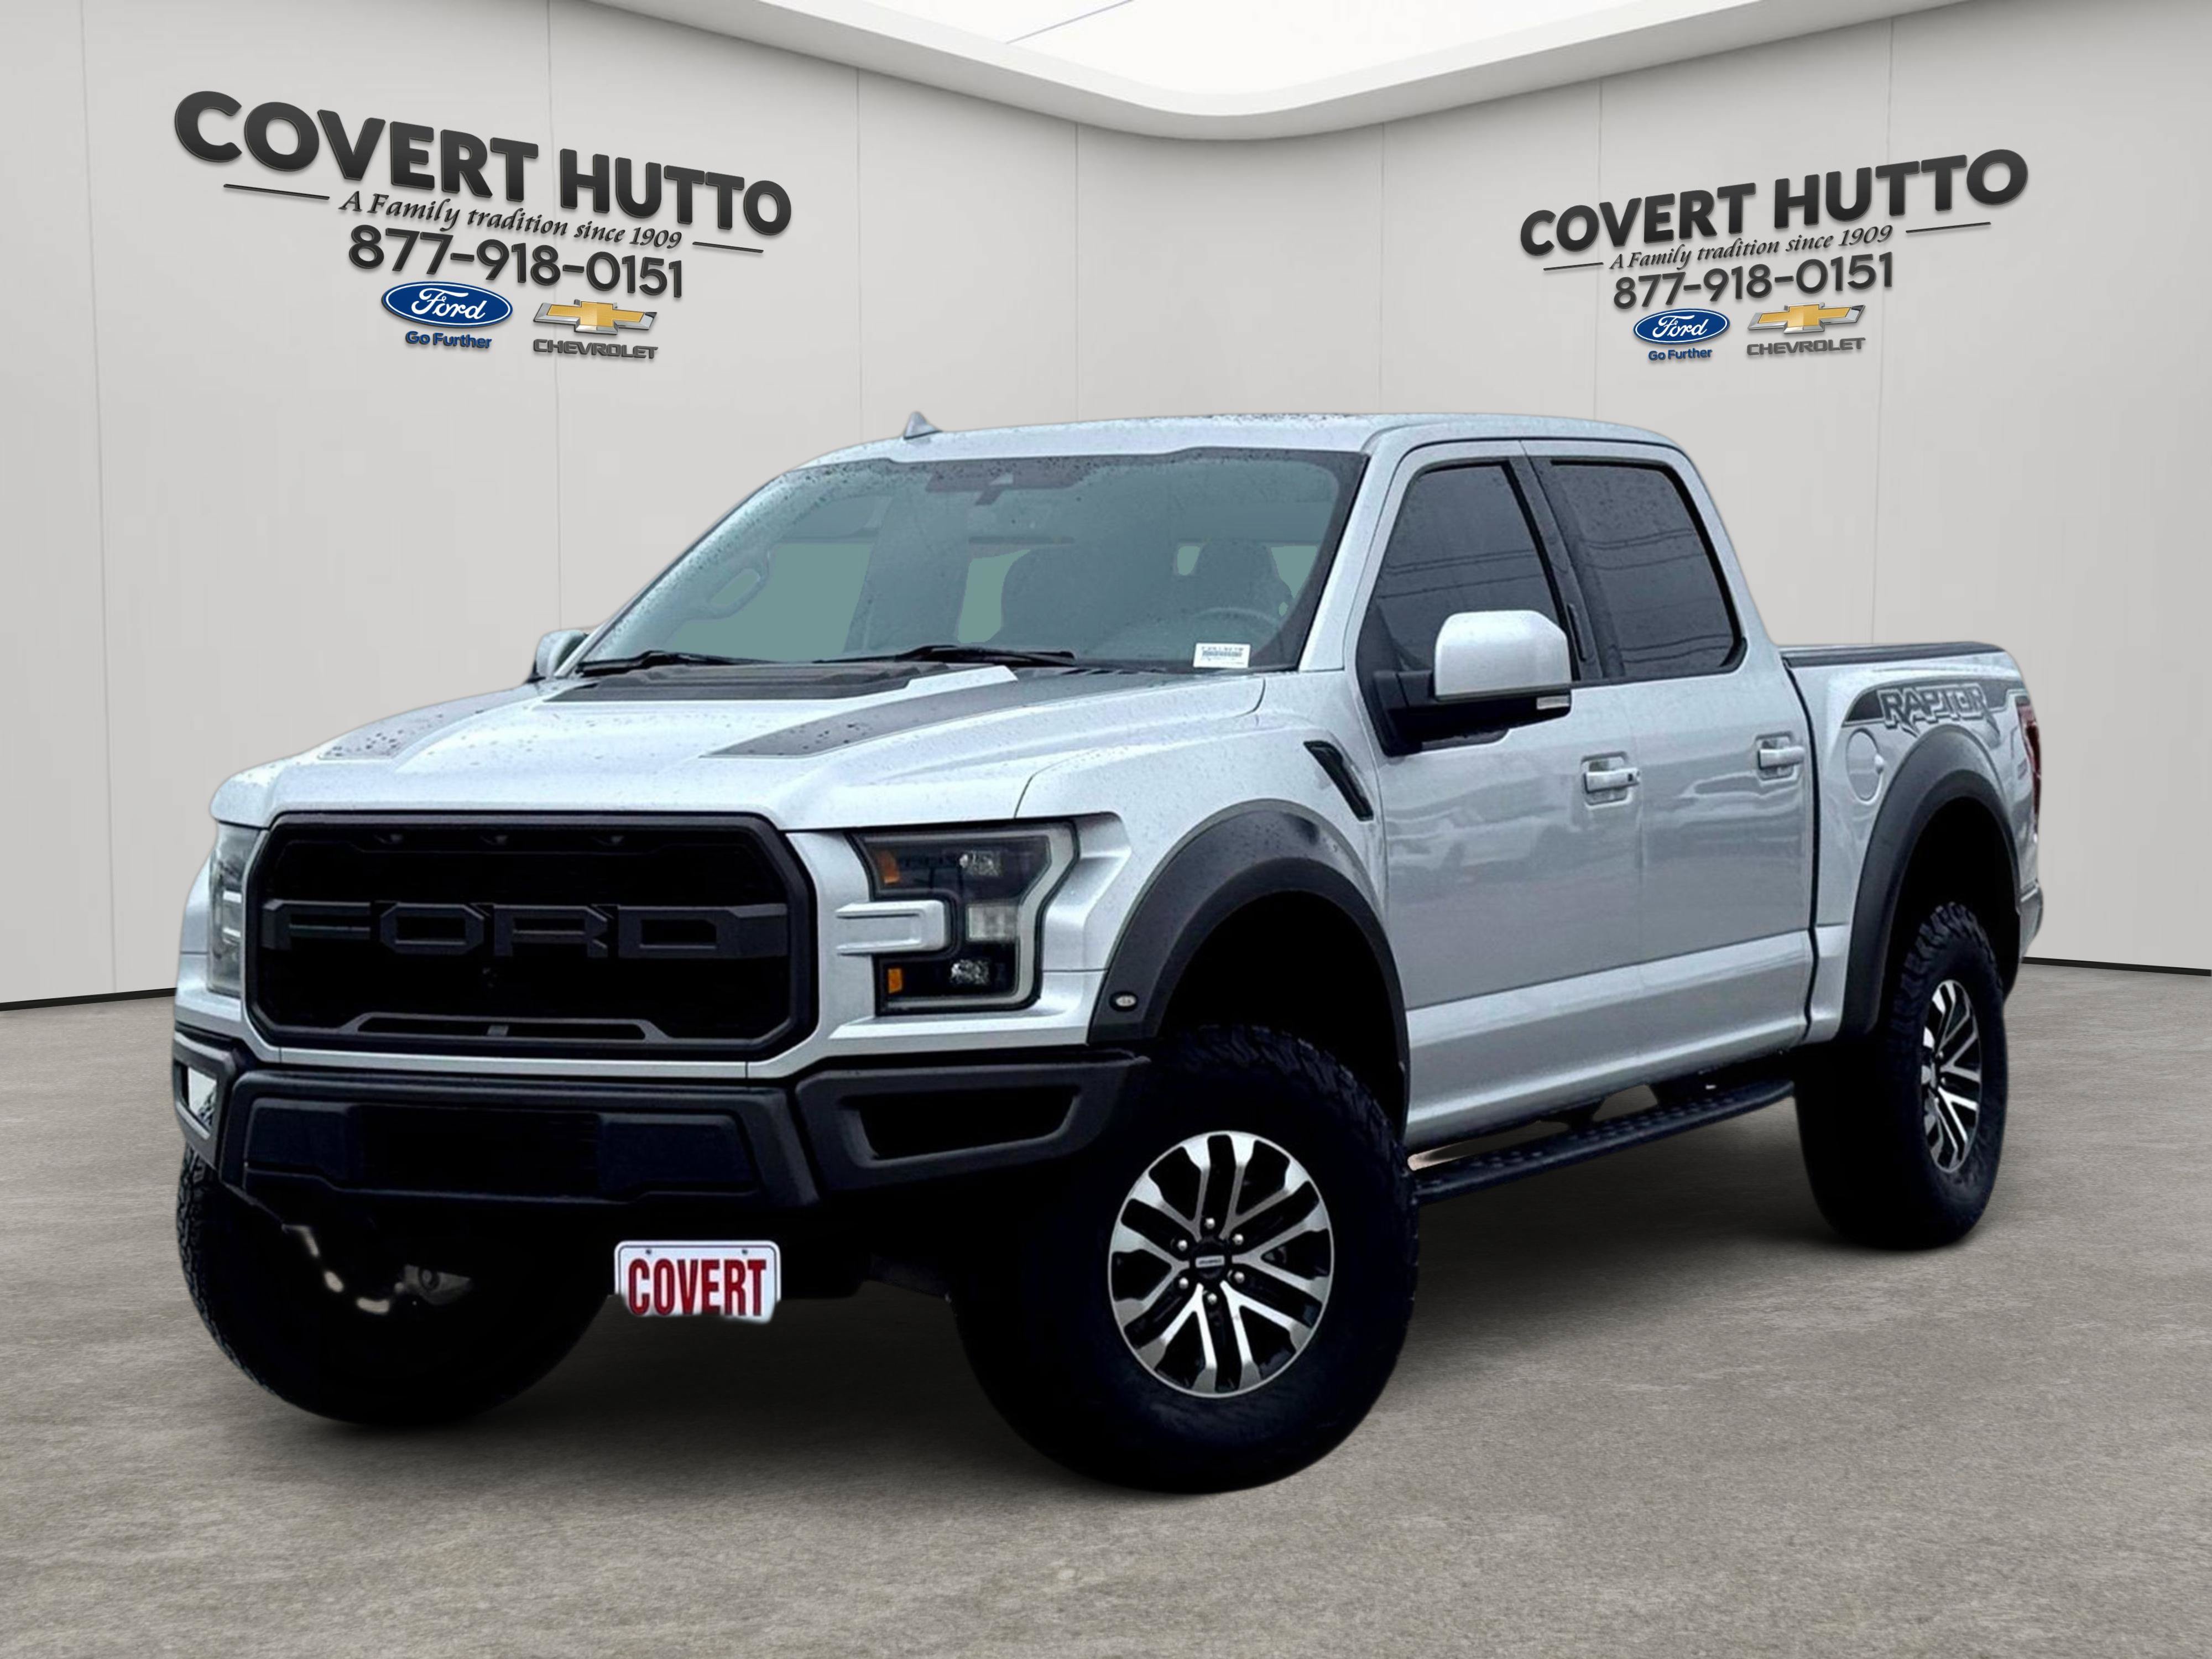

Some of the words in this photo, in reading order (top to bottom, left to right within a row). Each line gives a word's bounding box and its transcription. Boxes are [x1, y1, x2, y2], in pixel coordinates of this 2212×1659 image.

[174, 90, 539, 202] COVERT
[560, 148, 791, 237] HUTTO
[338, 191, 362, 212] A
[367, 193, 460, 232] Family
[467, 208, 568, 236] tradition
[574, 221, 625, 243] since
[629, 227, 682, 249] 1909
[1520, 182, 1756, 257] COVERT
[1774, 149, 2028, 229] HUTTO
[348, 225, 682, 298] 877-918-0151
[1609, 254, 1624, 269] A
[1627, 244, 1692, 270] Family
[1697, 238, 1780, 261] tradition
[1785, 234, 1834, 252] since
[1838, 225, 1893, 247] 1909
[411, 287, 487, 320] Ford
[1614, 252, 1892, 309] 877-918-0151
[405, 330, 430, 345] Go
[434, 332, 492, 349] Further
[533, 338, 659, 359] CHEVROLET
[1648, 350, 1666, 361] Go
[1668, 348, 1712, 360] Further
[1652, 315, 1709, 338] Ford
[1746, 337, 1866, 356] CHEVROLET
[1877, 682, 2000, 740] RAPTOR
[261, 898, 747, 959] FORD
[628, 1258, 767, 1317] COVERT
